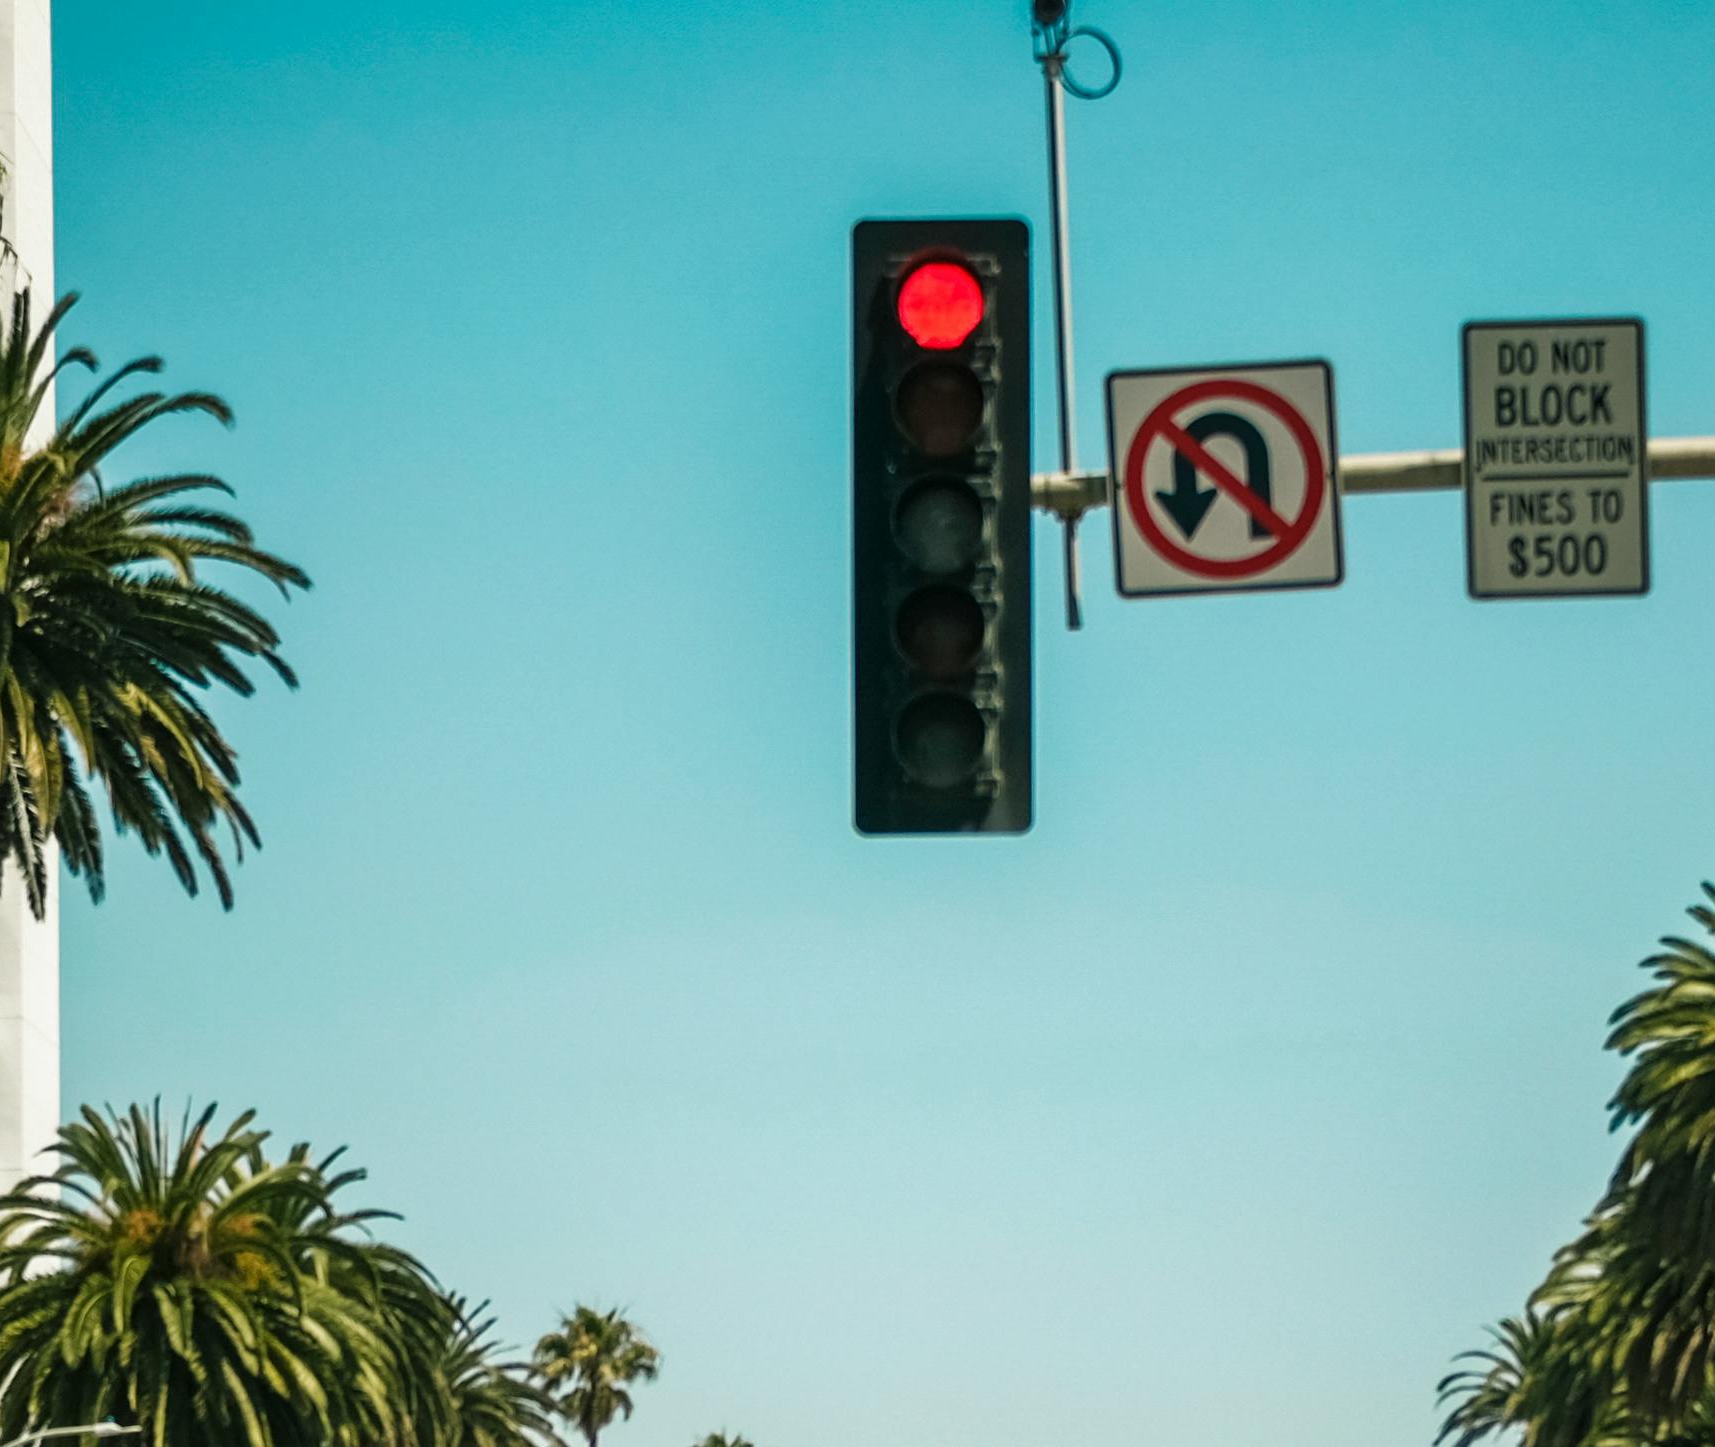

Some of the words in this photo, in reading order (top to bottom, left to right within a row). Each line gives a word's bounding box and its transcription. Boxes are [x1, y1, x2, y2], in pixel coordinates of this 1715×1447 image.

[1497, 340, 1537, 375] DO
[1551, 339, 1606, 375] NOT
[1494, 383, 1613, 428] BLOCK
[1476, 435, 1634, 466] INTERSECTION
[1489, 490, 1576, 527] FINES
[1589, 489, 1624, 525] TO
[1508, 533, 1608, 578] $500
